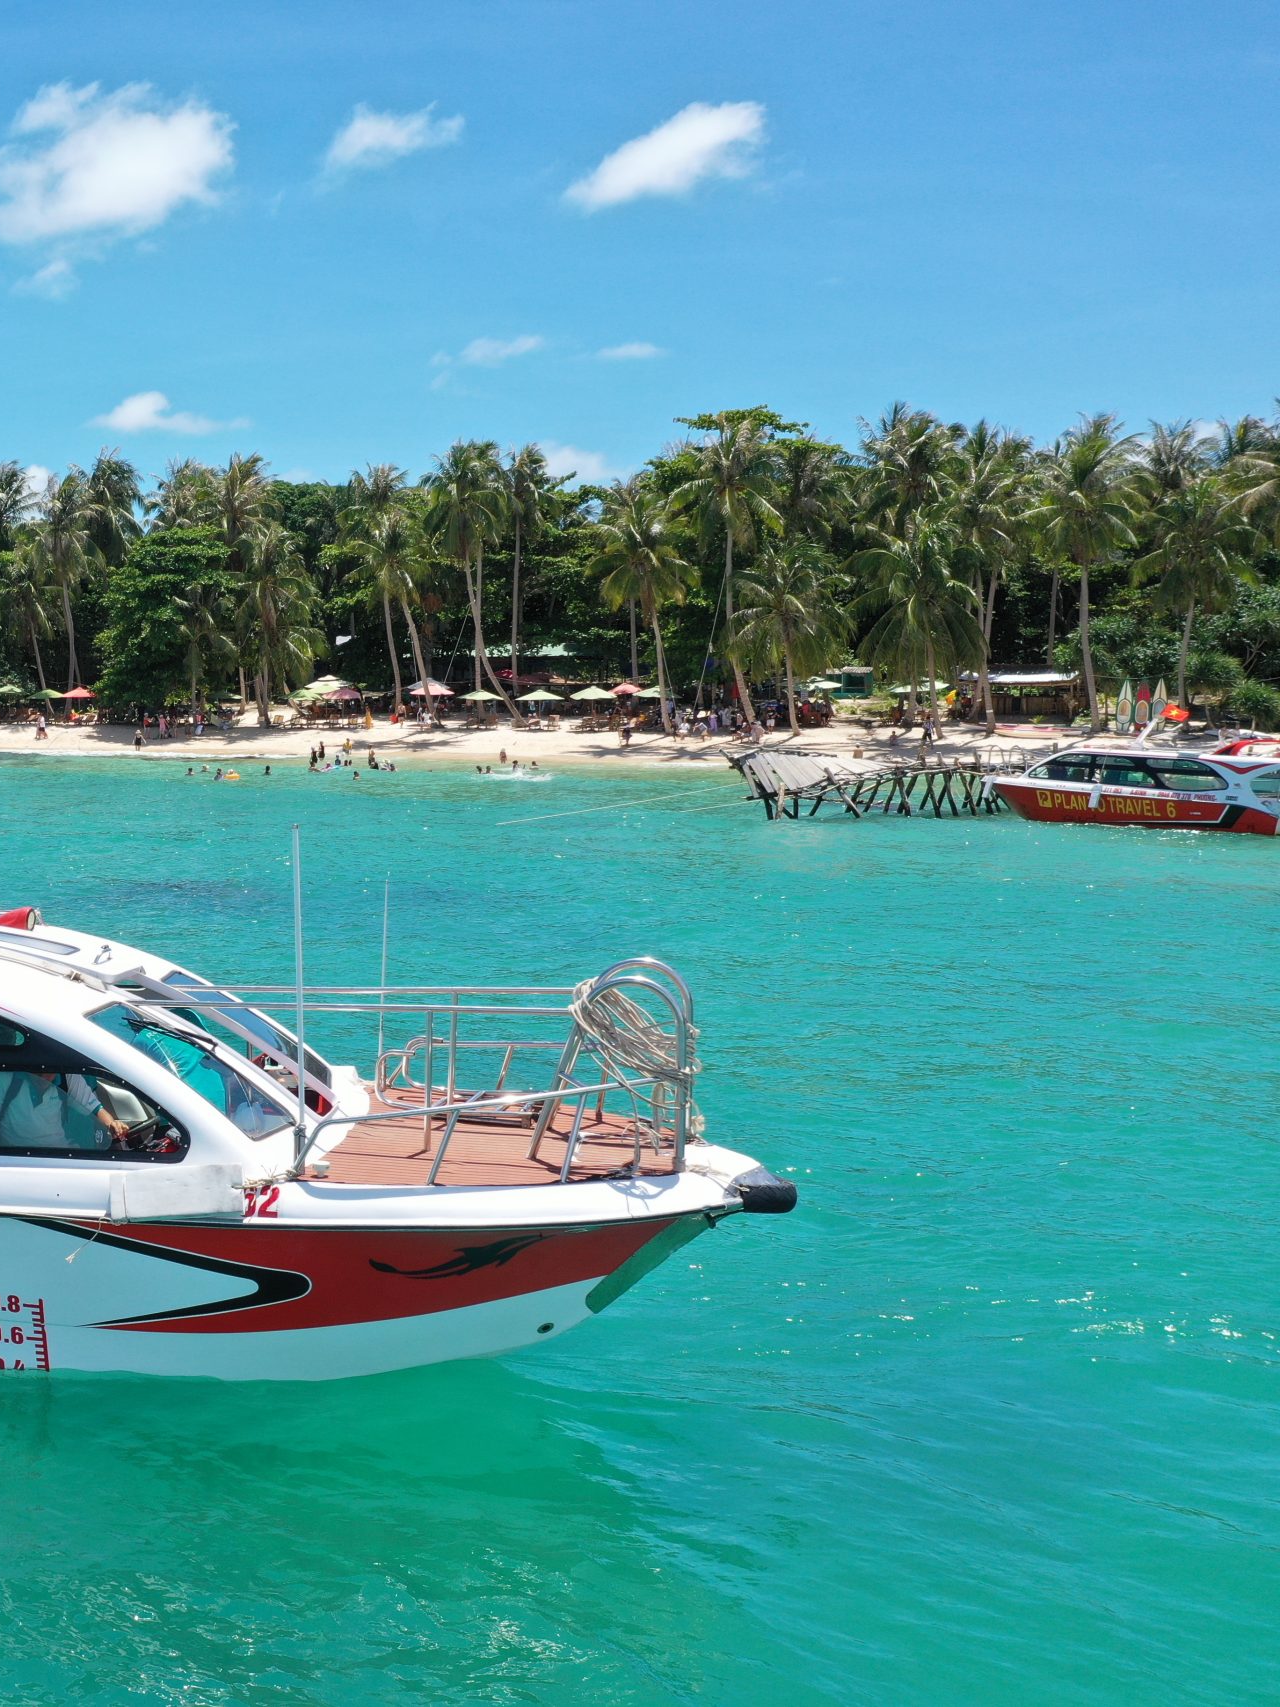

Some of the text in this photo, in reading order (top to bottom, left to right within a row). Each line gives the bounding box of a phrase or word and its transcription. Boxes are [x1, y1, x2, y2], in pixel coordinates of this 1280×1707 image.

[1053, 793, 1106, 813] PLANO
[1107, 797, 1162, 816] TRAVEL
[1166, 801, 1177, 818] 6
